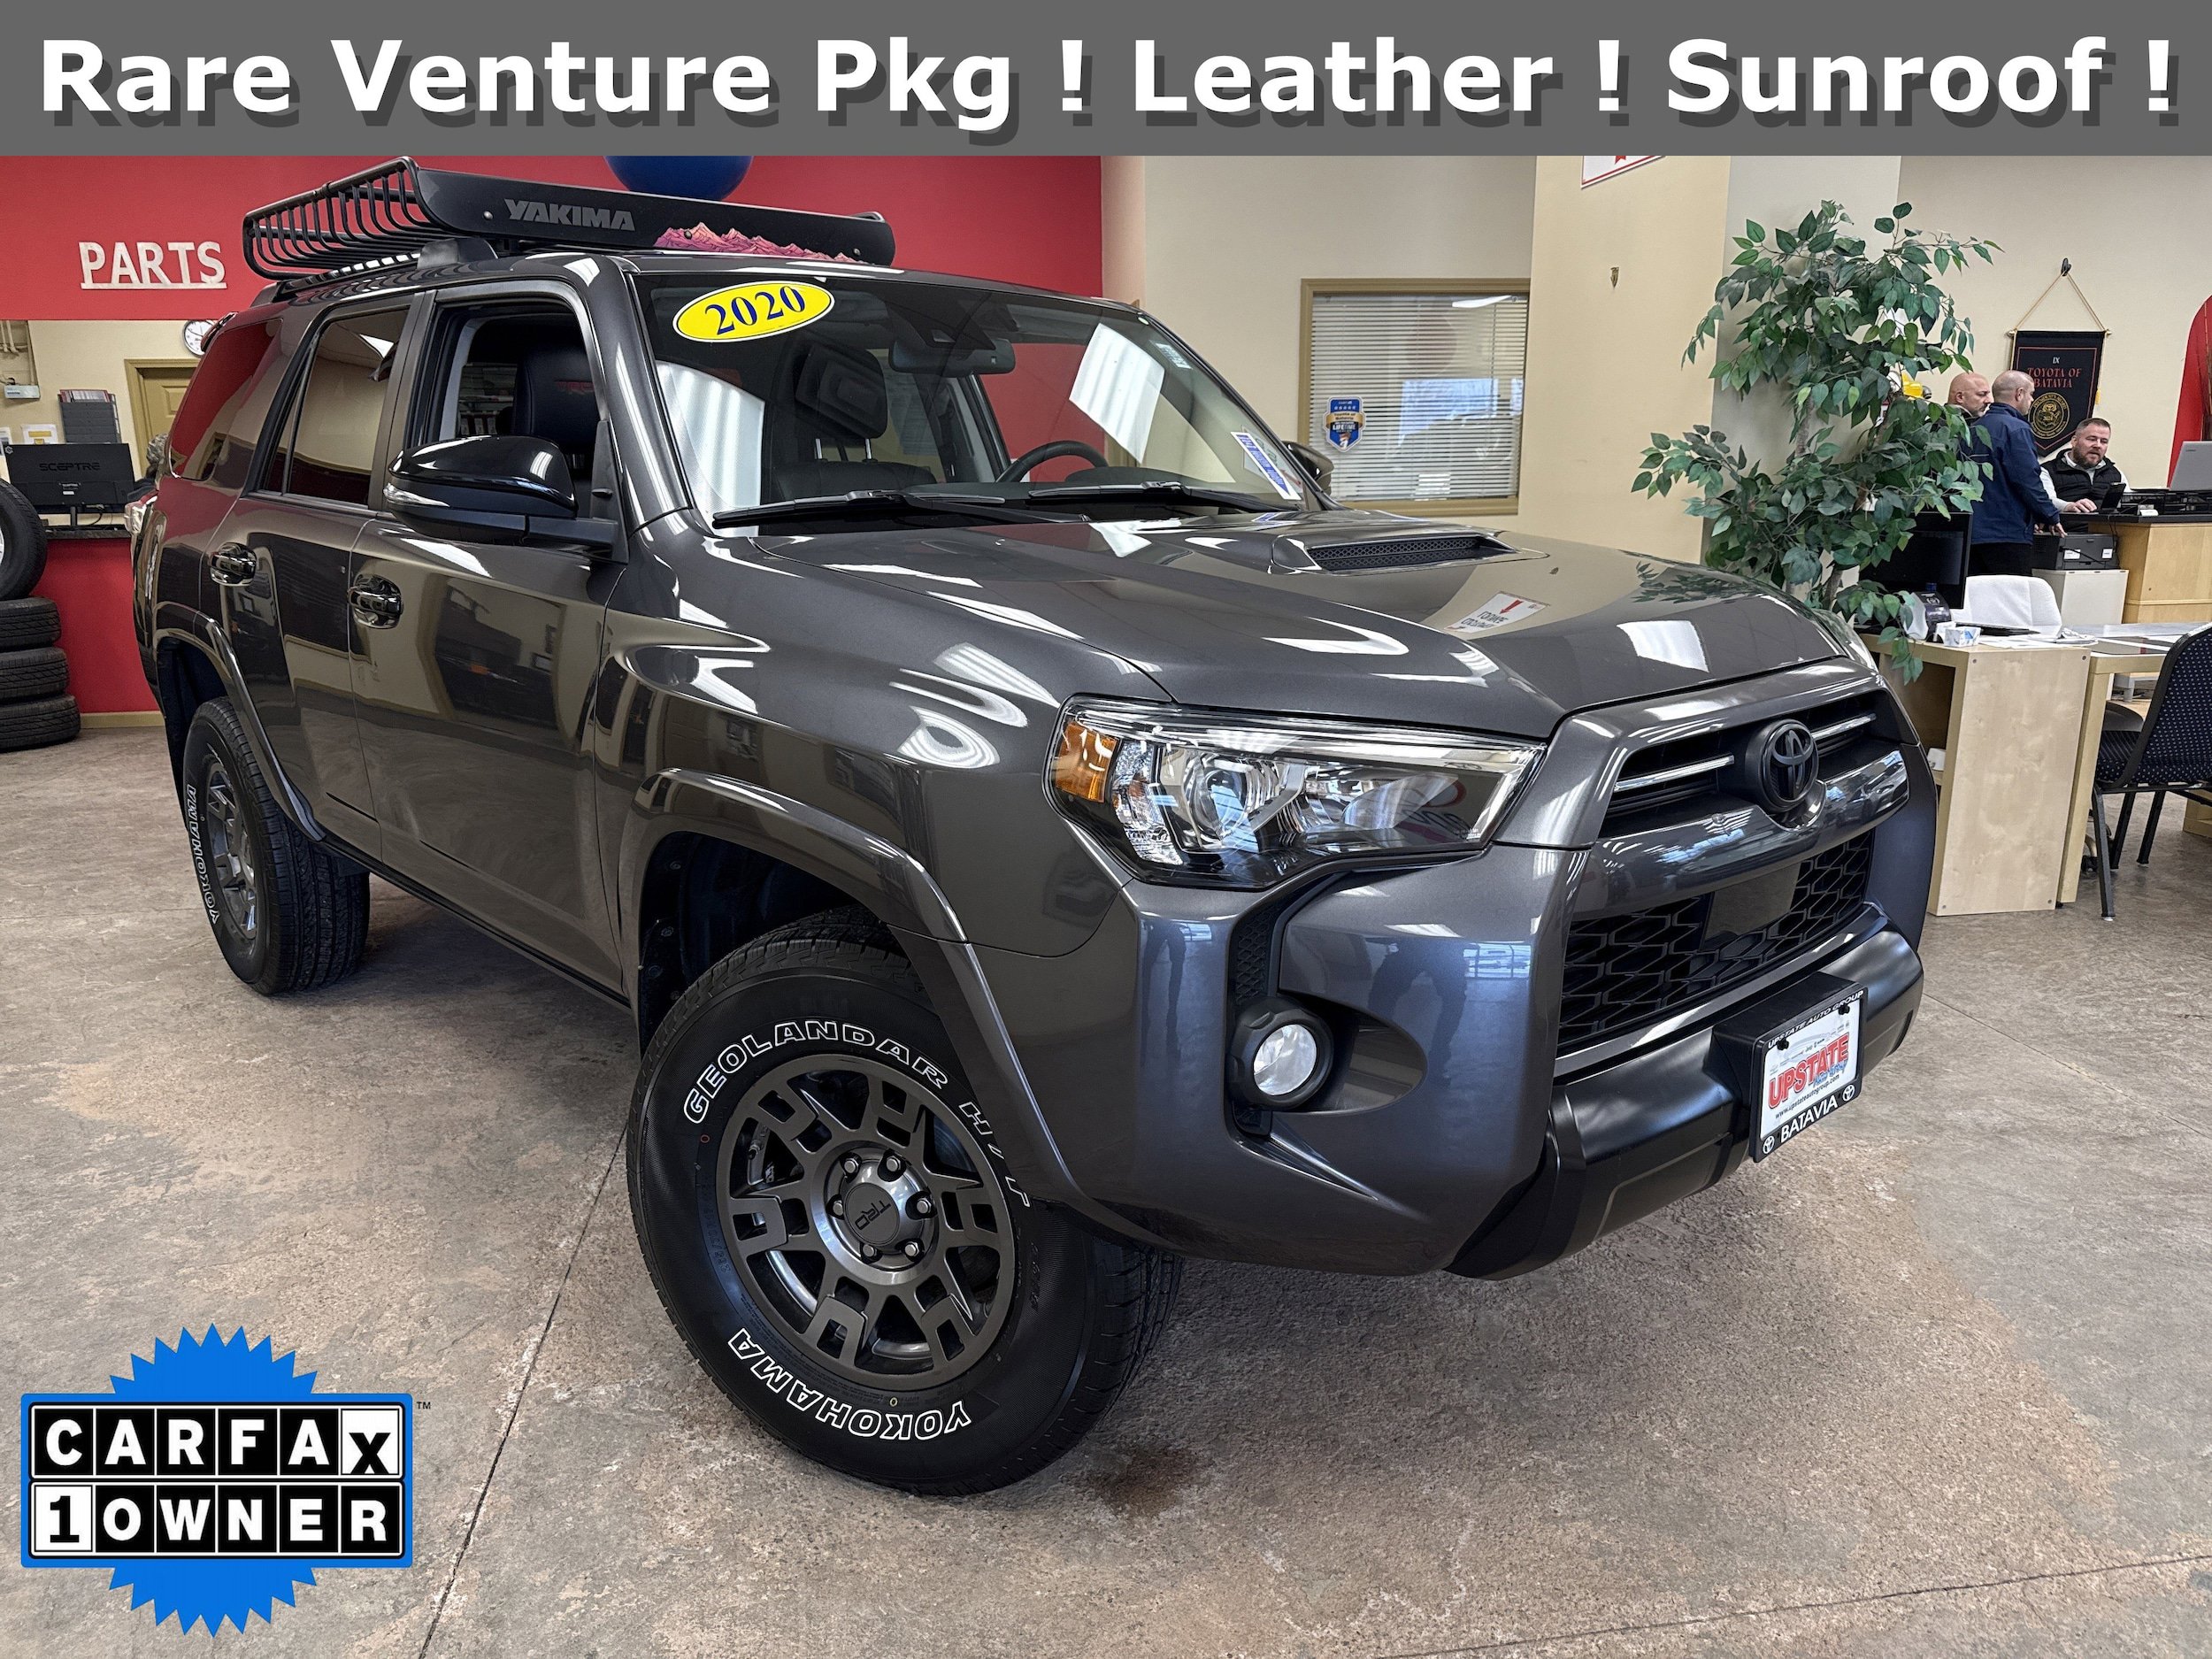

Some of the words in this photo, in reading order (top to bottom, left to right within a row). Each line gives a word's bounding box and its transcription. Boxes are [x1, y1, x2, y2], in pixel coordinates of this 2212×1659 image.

[504, 198, 636, 232] YAKIMA
[78, 241, 227, 284] PARTS
[704, 285, 806, 336] 2020
[2027, 367, 2065, 378] TOYOTA
[2069, 367, 2083, 378] OF
[2035, 378, 2072, 388] BATAVIA
[39, 462, 101, 472] SCEPTRE
[186, 783, 220, 925] YOKOHAMA
[1768, 1021, 1806, 1049] UPSTATE
[1806, 1007, 1832, 1025] AUTO
[1832, 989, 1864, 1010] GROUP
[683, 1020, 949, 1125] GEOLANDAR
[1768, 1032, 1850, 1110] UPSTATE
[1780, 1094, 1839, 1143] BATAVIA
[855, 1200, 892, 1231] TRD
[728, 1327, 972, 1440] YOKOHAMA
